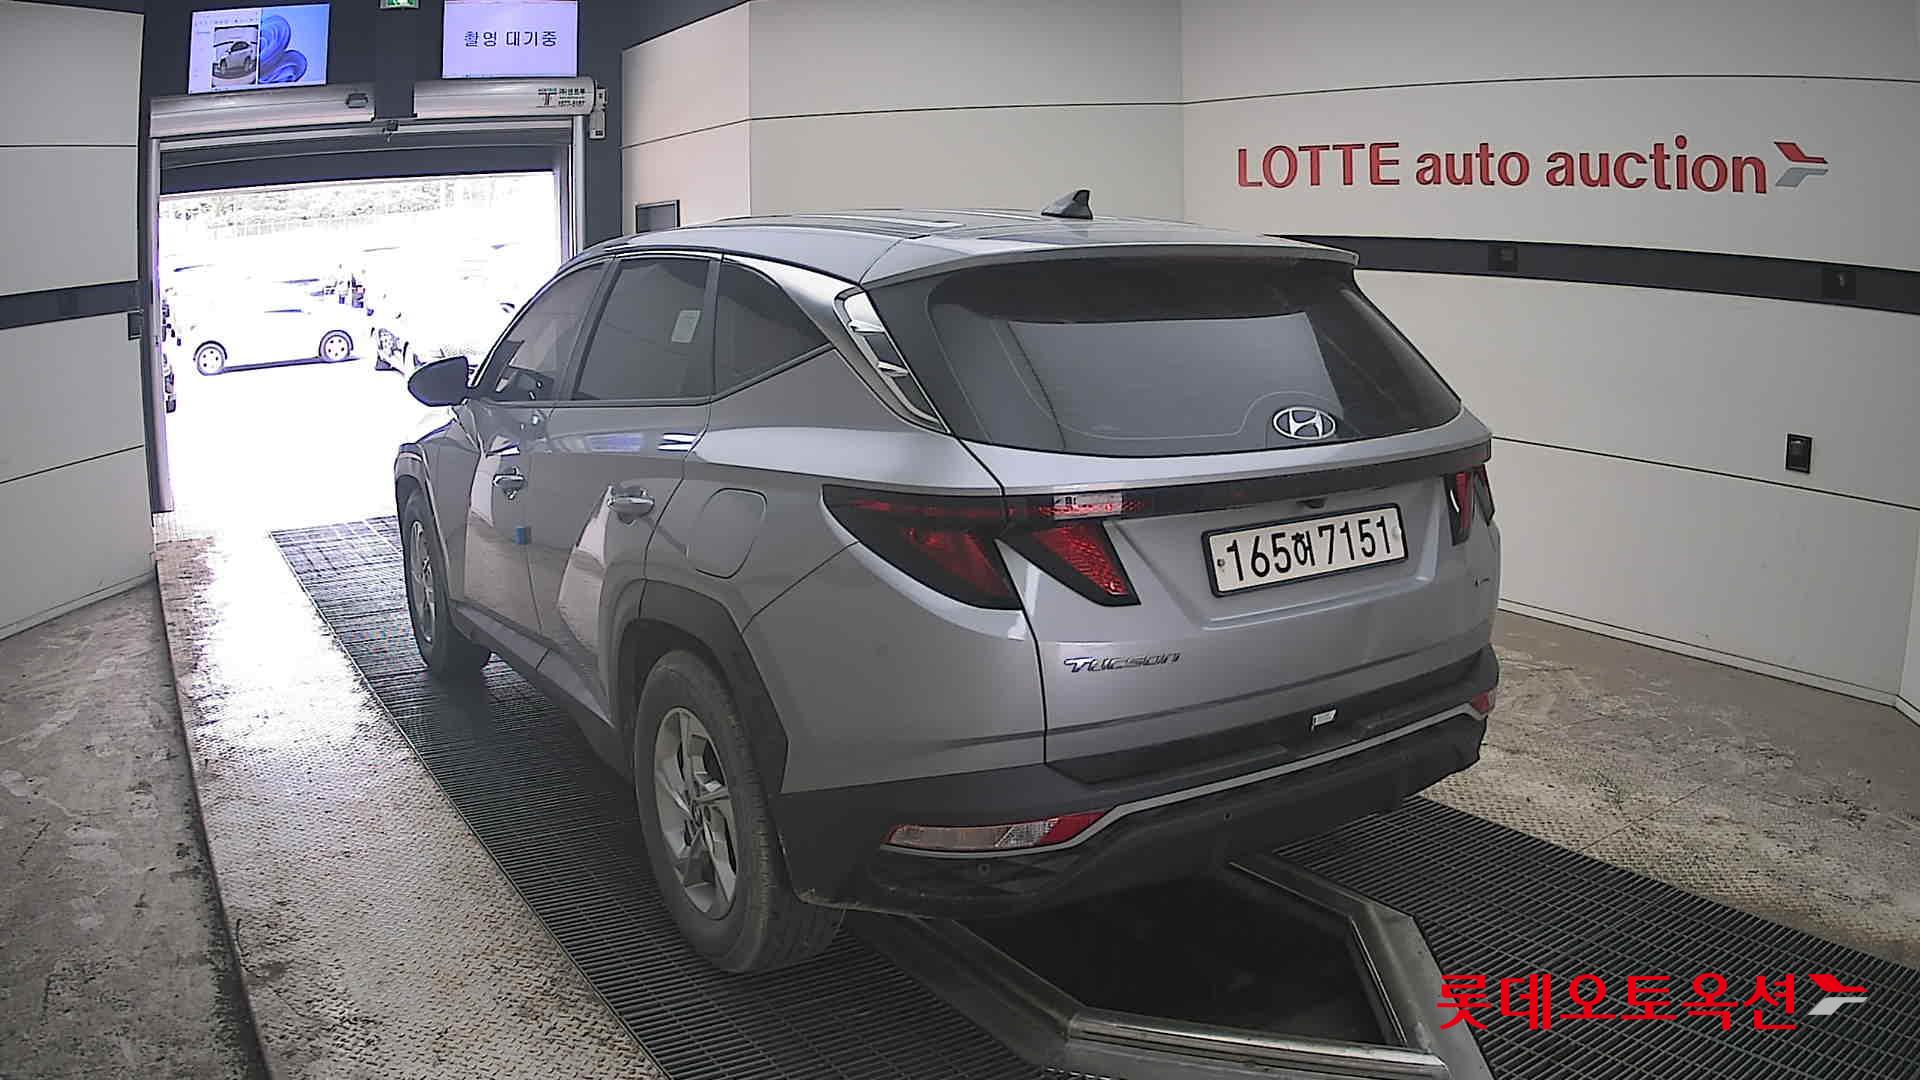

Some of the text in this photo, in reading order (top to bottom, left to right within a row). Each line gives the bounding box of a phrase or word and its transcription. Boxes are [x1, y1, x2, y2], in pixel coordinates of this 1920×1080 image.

[464, 30, 557, 47] 촬영 대기중
[1237, 134, 1767, 194] LOTTE auto auction
